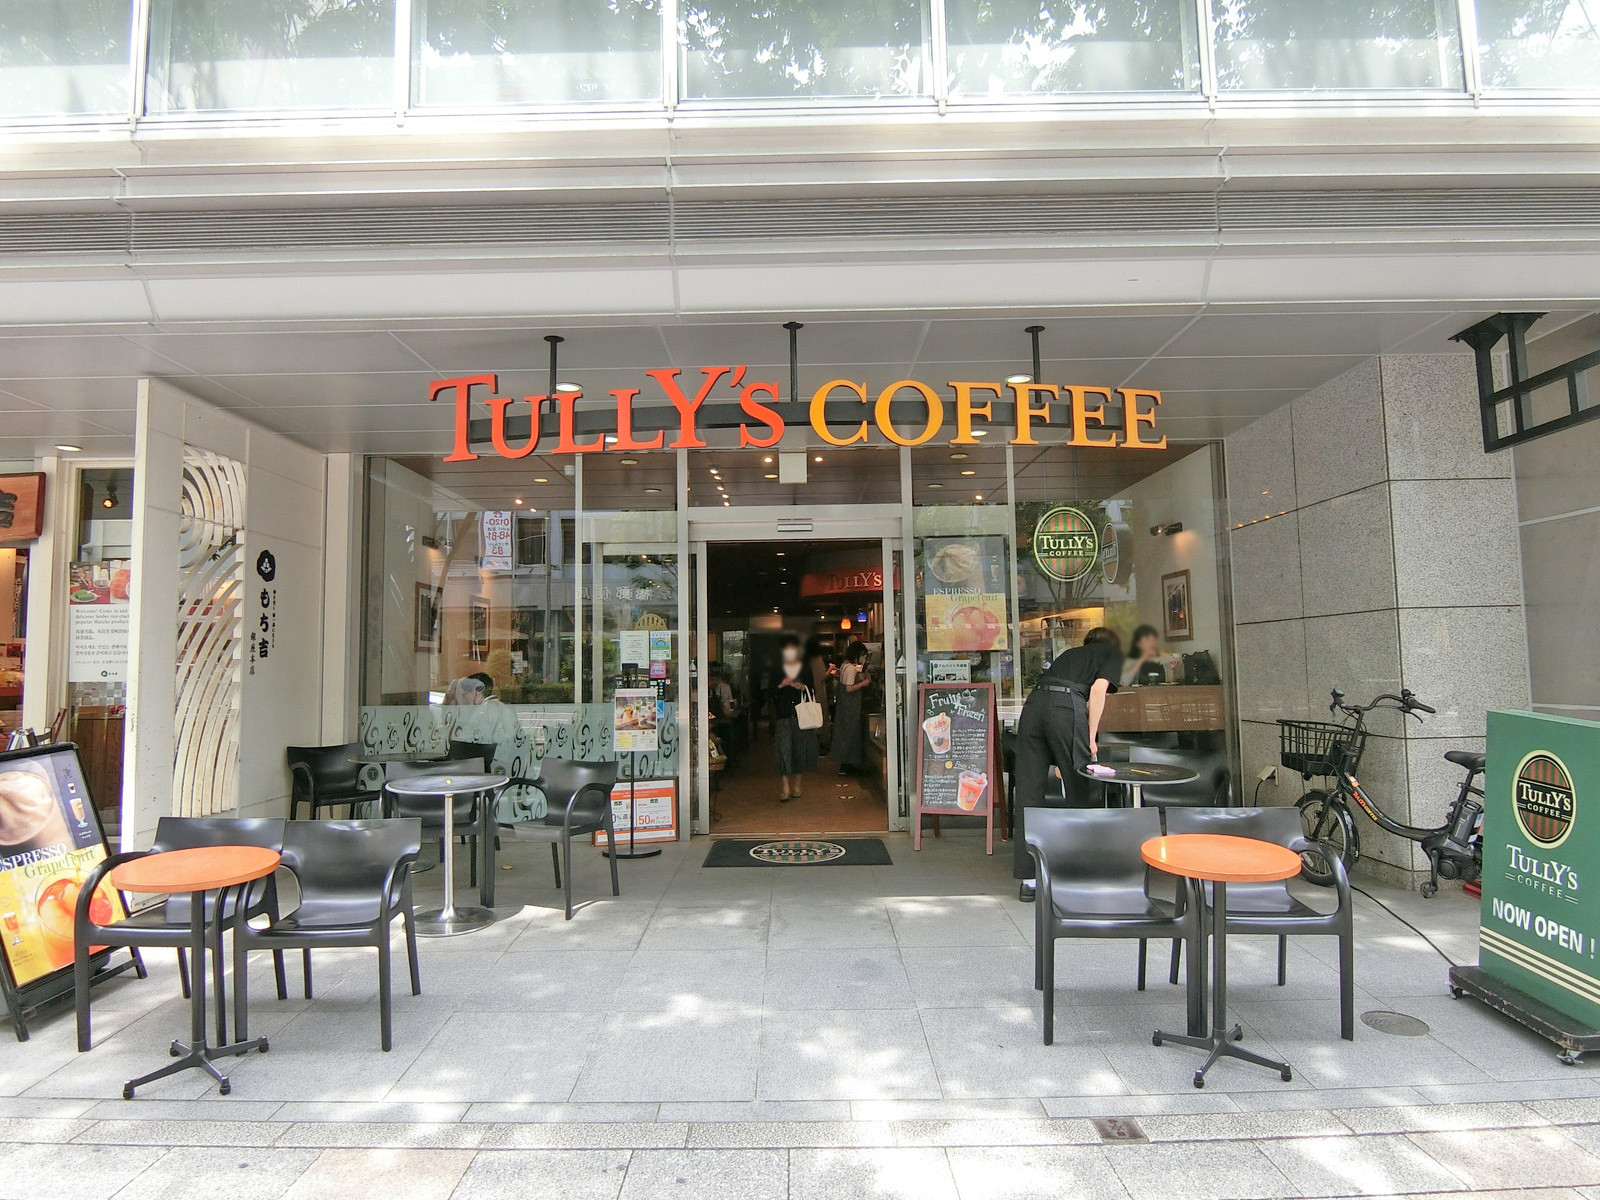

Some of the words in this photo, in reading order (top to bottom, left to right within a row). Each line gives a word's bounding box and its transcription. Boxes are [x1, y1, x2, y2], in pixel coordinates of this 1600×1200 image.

[429, 365, 786, 463] TULLY'S
[809, 379, 1168, 450] COFFEE
[1039, 535, 1094, 550] TULLY'S
[932, 587, 982, 596] ESPRESSO
[258, 587, 270, 659] もち吉
[248, 631, 257, 676] 銀座本店
[956, 703, 985, 722] Frozen
[1518, 781, 1572, 812] TULLY'S
[1526, 802, 1561, 818] COFFEE
[24, 846, 96, 879] Grapefruit
[1506, 843, 1579, 891] TULLY'S
[1517, 874, 1564, 899] COFFEE
[1492, 897, 1532, 931] NOW
[1534, 915, 1584, 954] OPEN
[1589, 937, 1596, 959] !
